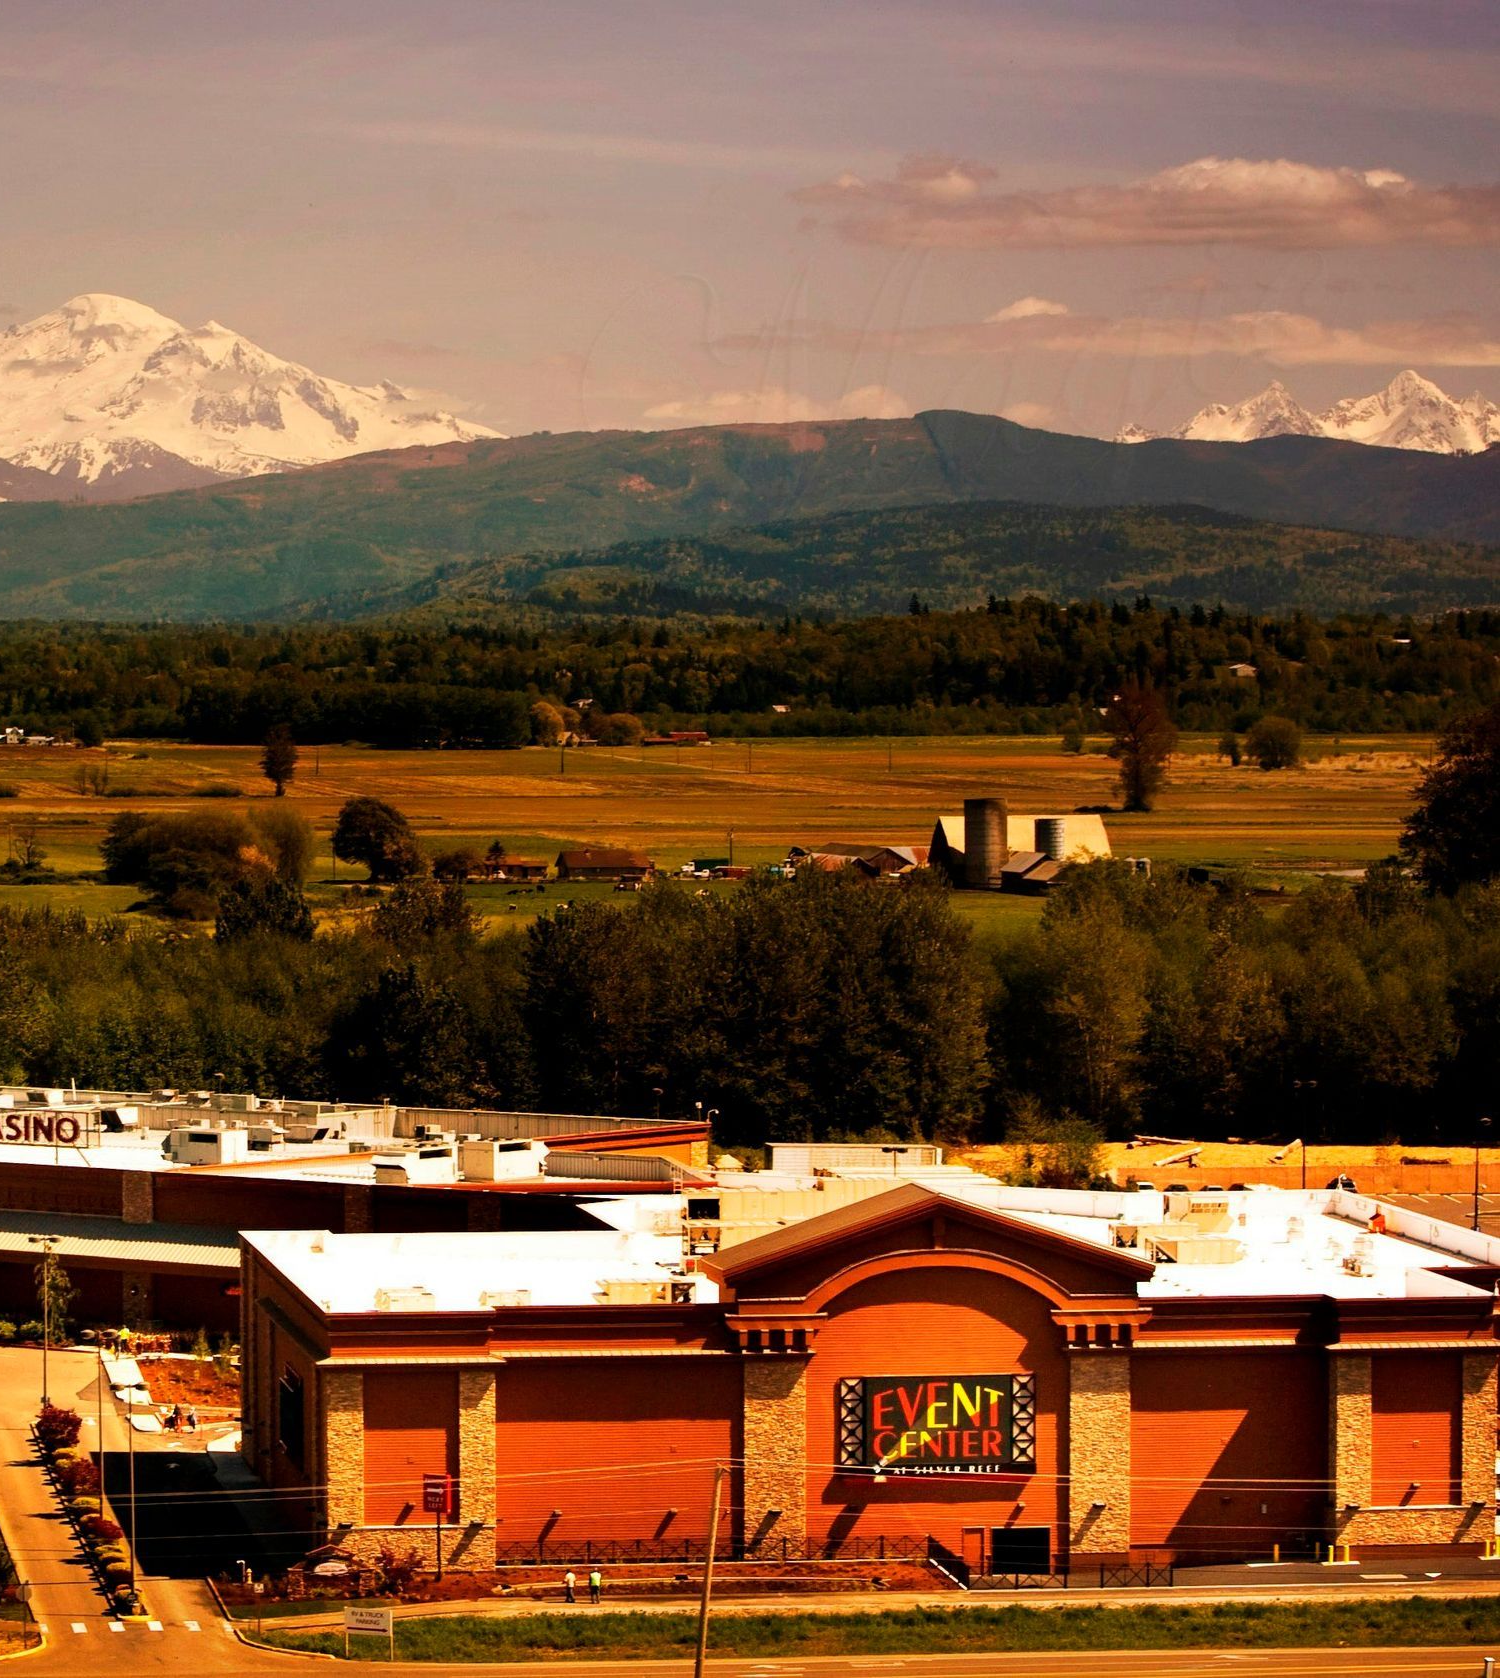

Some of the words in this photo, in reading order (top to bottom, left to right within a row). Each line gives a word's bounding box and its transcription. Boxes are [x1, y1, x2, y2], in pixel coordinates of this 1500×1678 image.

[873, 1382, 1004, 1430] EVENT
[873, 1431, 1003, 1458] CENTER
[914, 1465, 961, 1474] SILVER
[968, 1464, 1001, 1473] REEF
